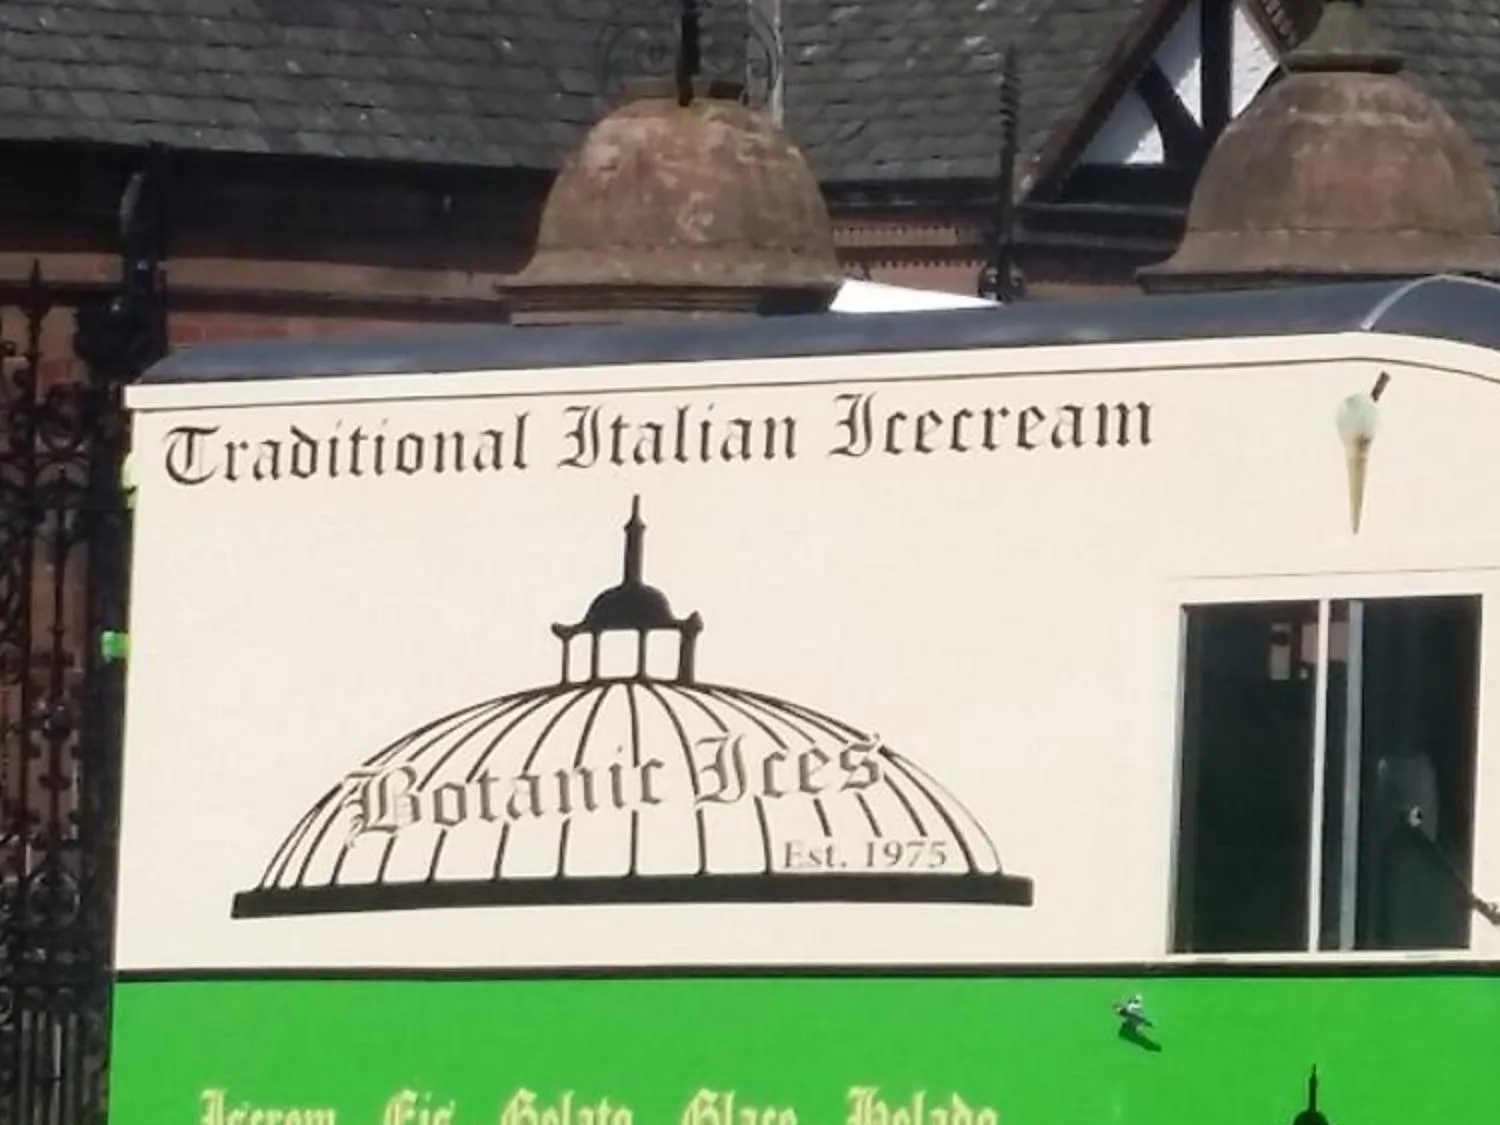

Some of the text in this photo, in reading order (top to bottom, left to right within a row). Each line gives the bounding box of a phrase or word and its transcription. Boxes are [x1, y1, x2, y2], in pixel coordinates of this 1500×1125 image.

[164, 390, 1152, 486] Traditional Italian Icecream
[340, 732, 882, 847] Botanic Ices
[784, 838, 947, 869] Est. 1975
